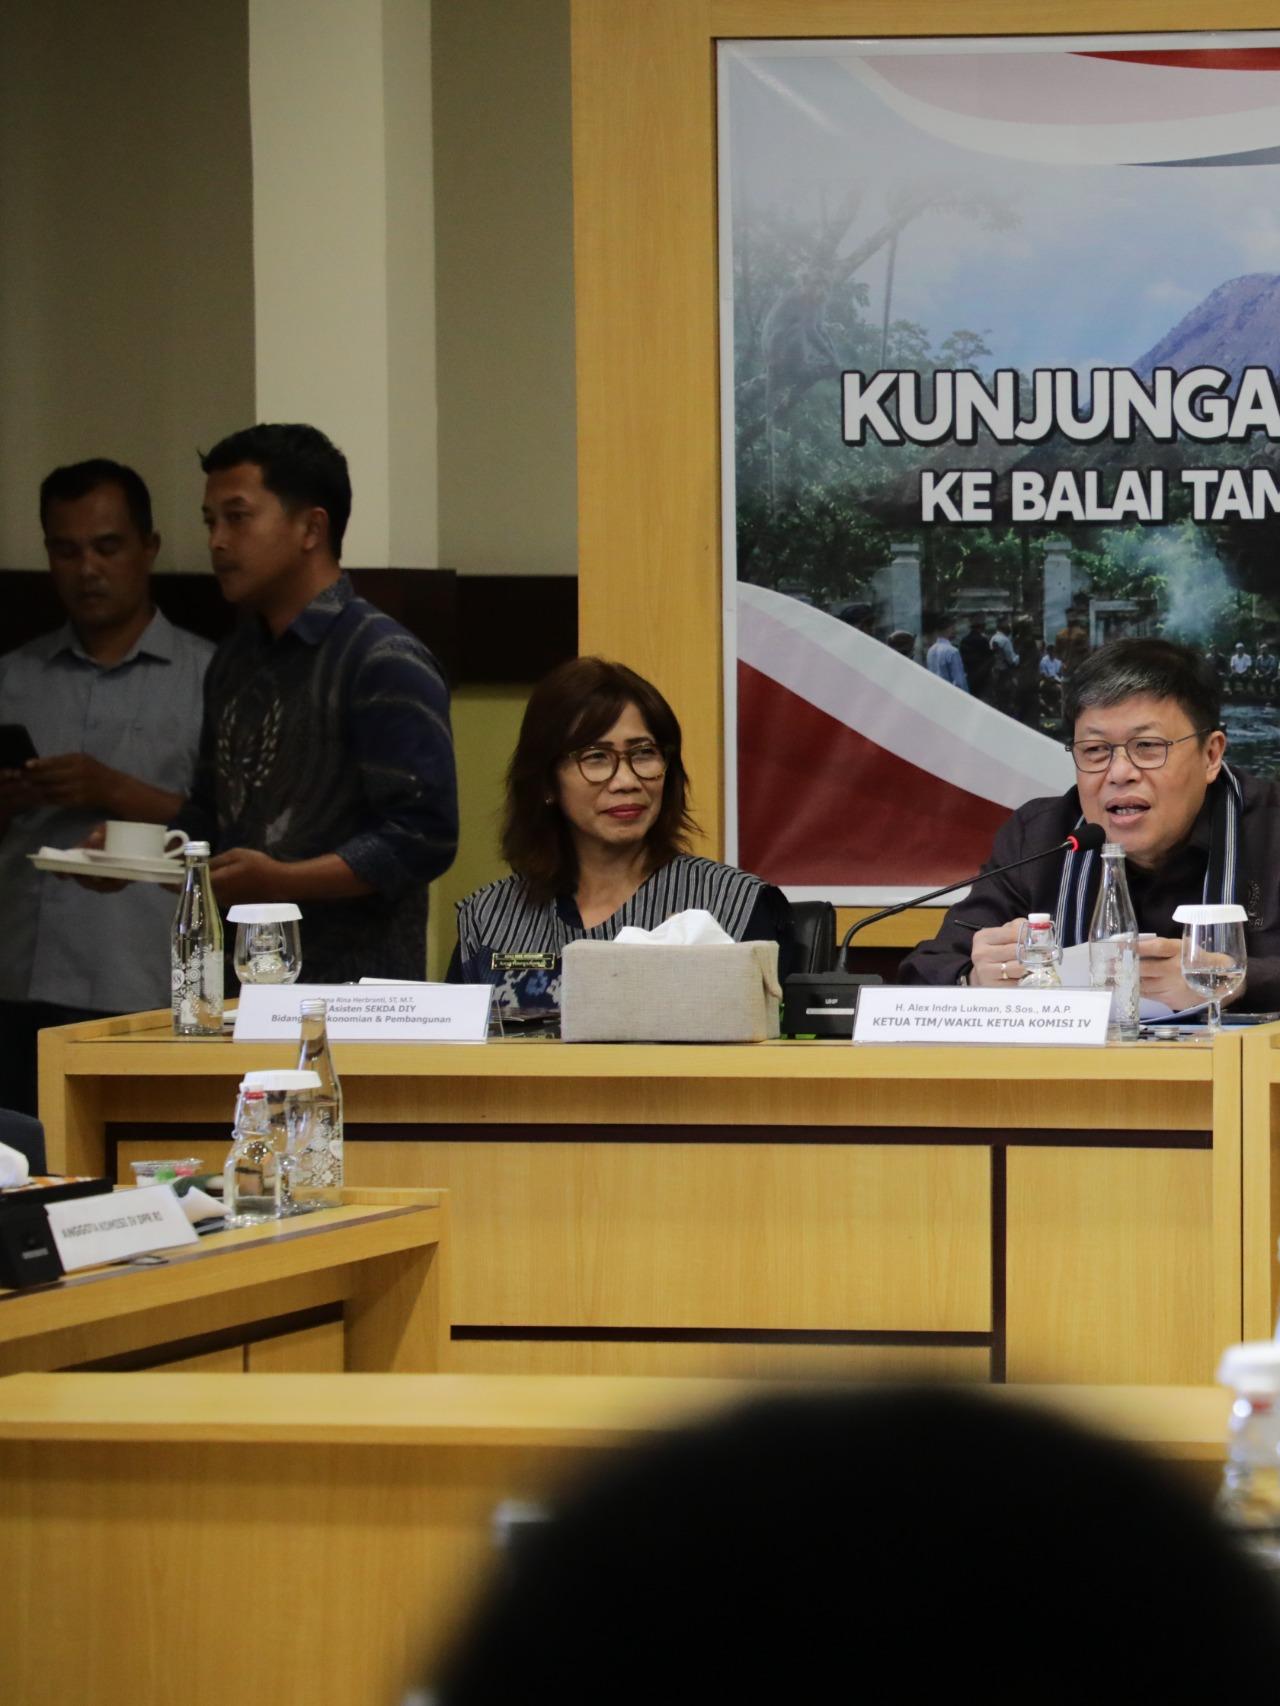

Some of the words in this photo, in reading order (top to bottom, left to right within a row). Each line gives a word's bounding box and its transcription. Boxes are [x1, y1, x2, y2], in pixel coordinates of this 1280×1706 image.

[921, 471, 993, 522] KE
[1011, 469, 1165, 521] BALAI
[328, 1004, 362, 1013] Asisten
[365, 1004, 396, 1013] SEKDA
[398, 1005, 416, 1013] DIY
[907, 1004, 929, 1013] Alex
[932, 1004, 958, 1013] Indra
[271, 1014, 303, 1024] Bidang
[327, 1015, 374, 1023] konomian
[375, 1015, 383, 1023] &
[385, 1015, 452, 1024] Pembangunan
[872, 1017, 911, 1027] KETUA
[914, 1017, 983, 1028] TIM/WAKIL
[986, 1018, 1025, 1028] KETUA
[1028, 1018, 1074, 1028] KOMISI
[1077, 1019, 1092, 1028] IV
